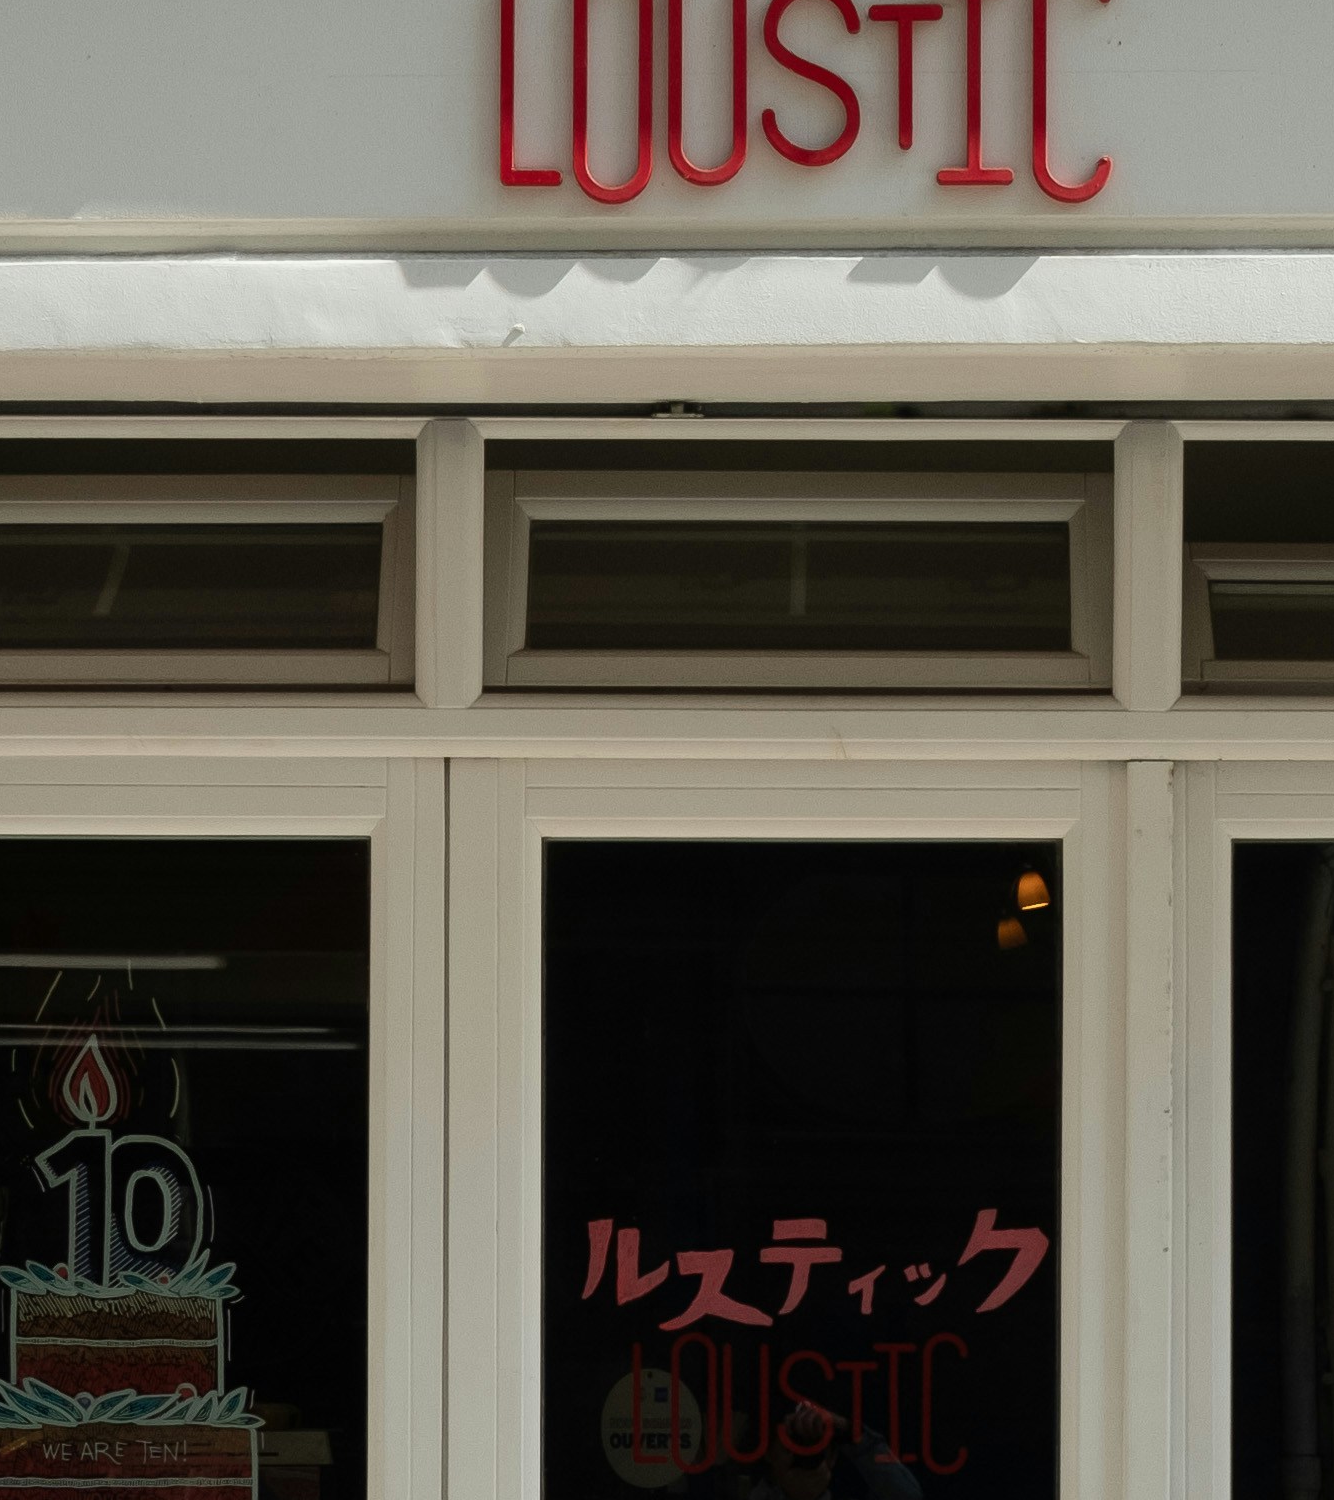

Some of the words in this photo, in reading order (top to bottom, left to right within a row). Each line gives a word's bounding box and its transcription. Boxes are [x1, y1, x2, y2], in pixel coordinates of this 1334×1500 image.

[34, 1128, 205, 1298] 10
[581, 1207, 1049, 1331] ルスティック
[42, 1443, 73, 1462] WE
[80, 1442, 128, 1466] ARE
[134, 1439, 188, 1463] TEN!
[609, 1433, 692, 1449] OUERS
[631, 1332, 968, 1475] LOUSTIC
